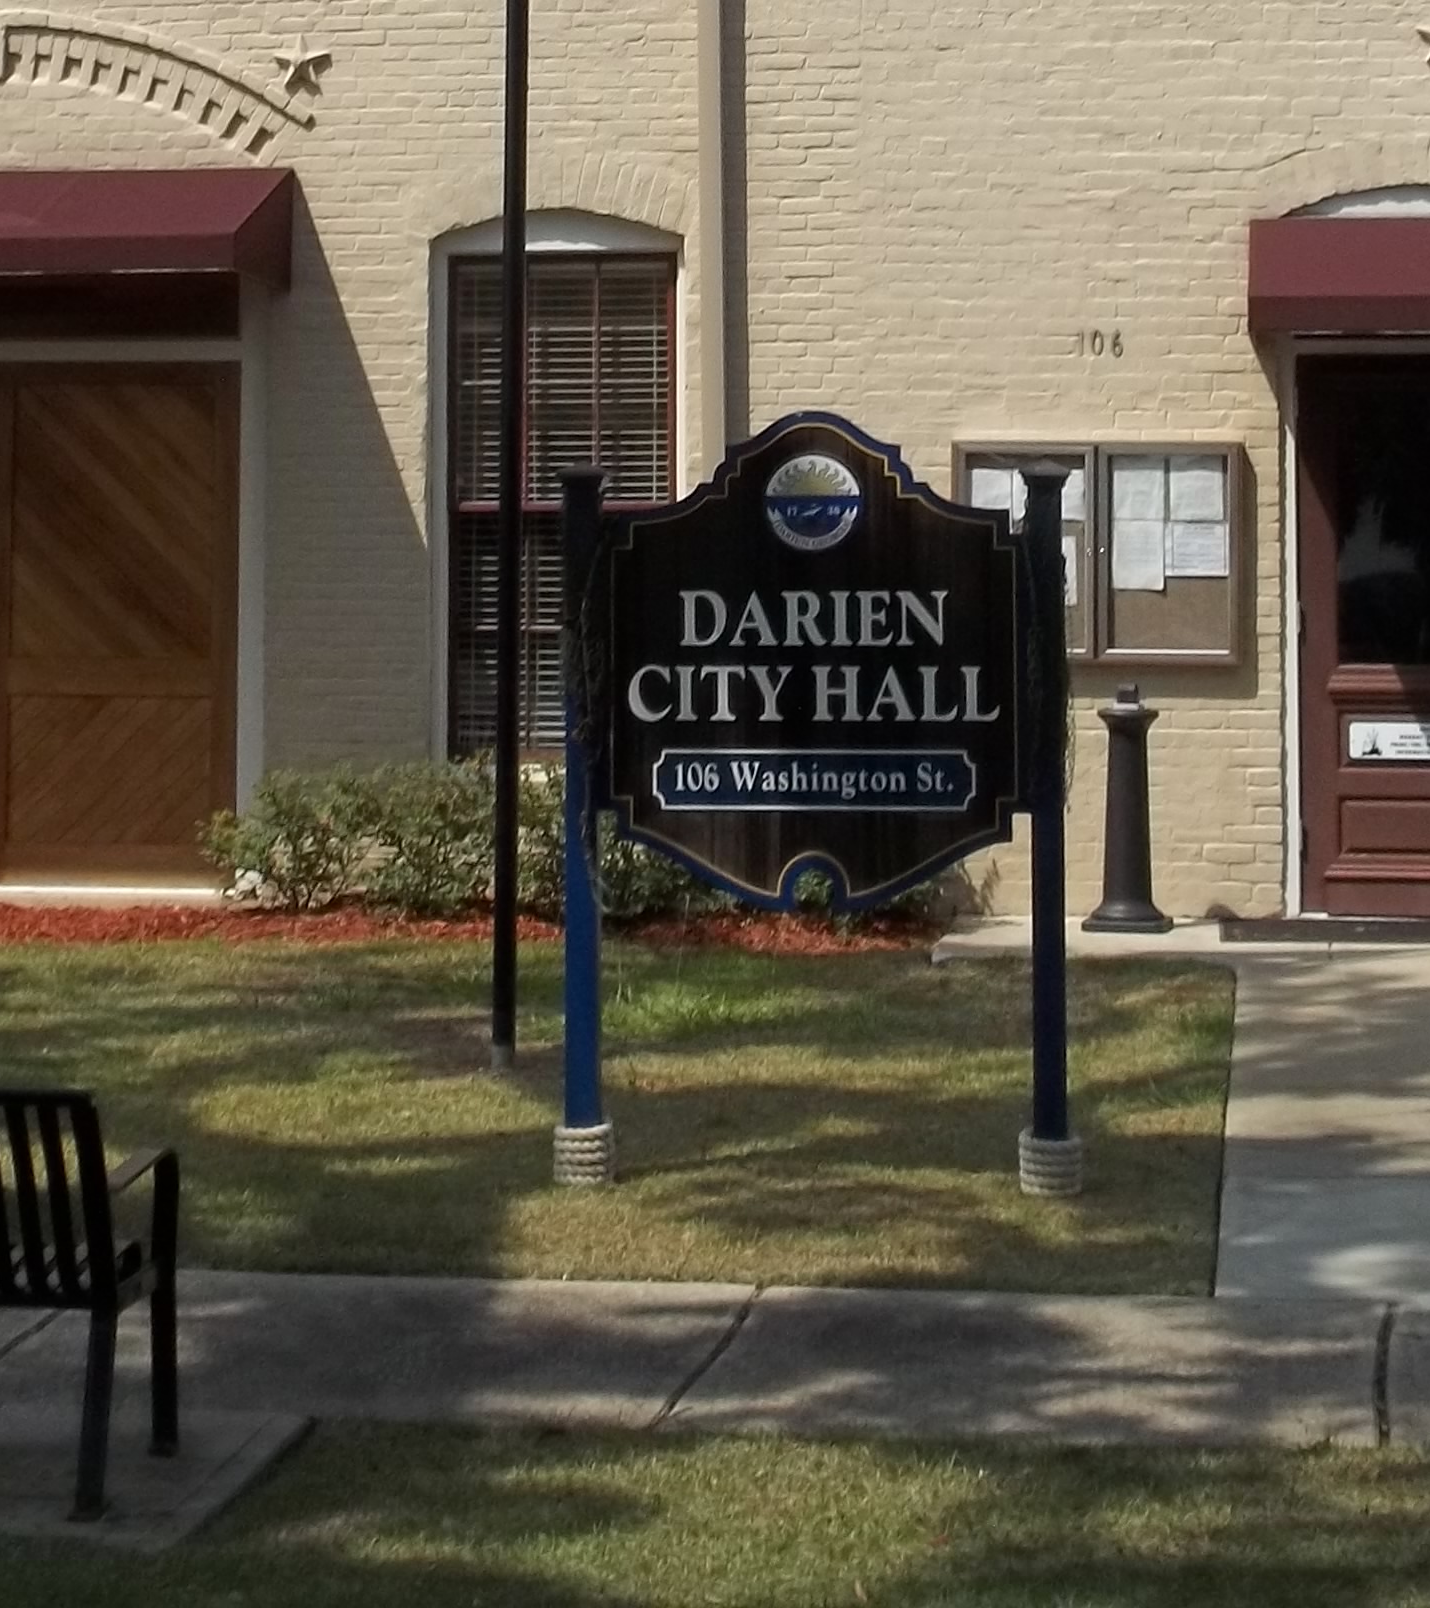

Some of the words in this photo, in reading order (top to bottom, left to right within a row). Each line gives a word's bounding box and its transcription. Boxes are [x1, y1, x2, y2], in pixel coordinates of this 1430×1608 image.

[1077, 328, 1124, 359] 106
[678, 590, 949, 647] DARIEN
[627, 663, 794, 723] CITY
[810, 664, 1001, 722] HALL
[674, 760, 721, 793] 106
[729, 760, 907, 800] Washington
[916, 761, 955, 793] St.
